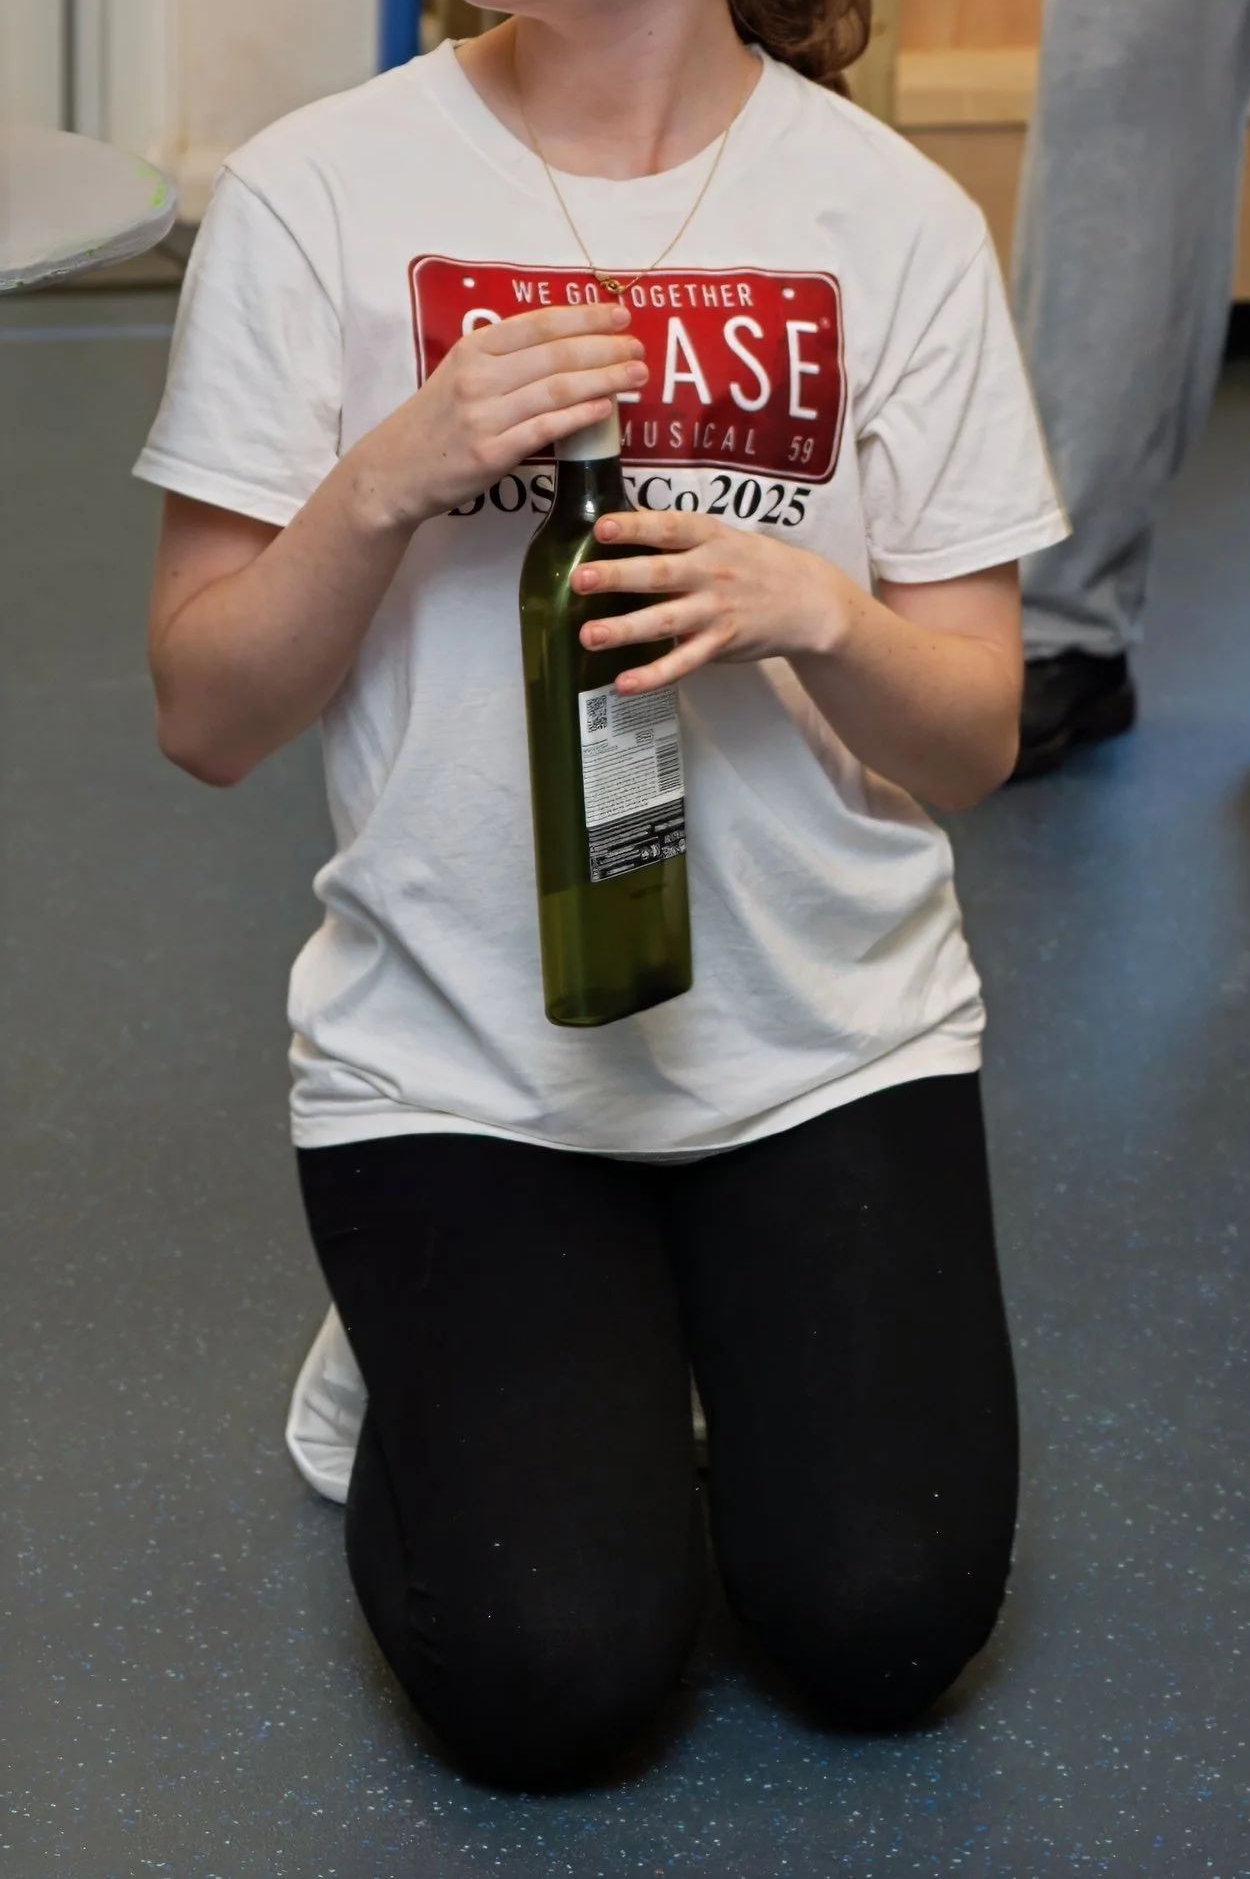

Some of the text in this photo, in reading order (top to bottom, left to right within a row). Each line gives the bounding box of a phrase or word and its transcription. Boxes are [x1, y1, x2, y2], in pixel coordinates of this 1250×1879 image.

[512, 279, 551, 305] WE
[566, 284, 599, 306] GO
[788, 436, 815, 463] 59
[706, 474, 812, 527] 2025
